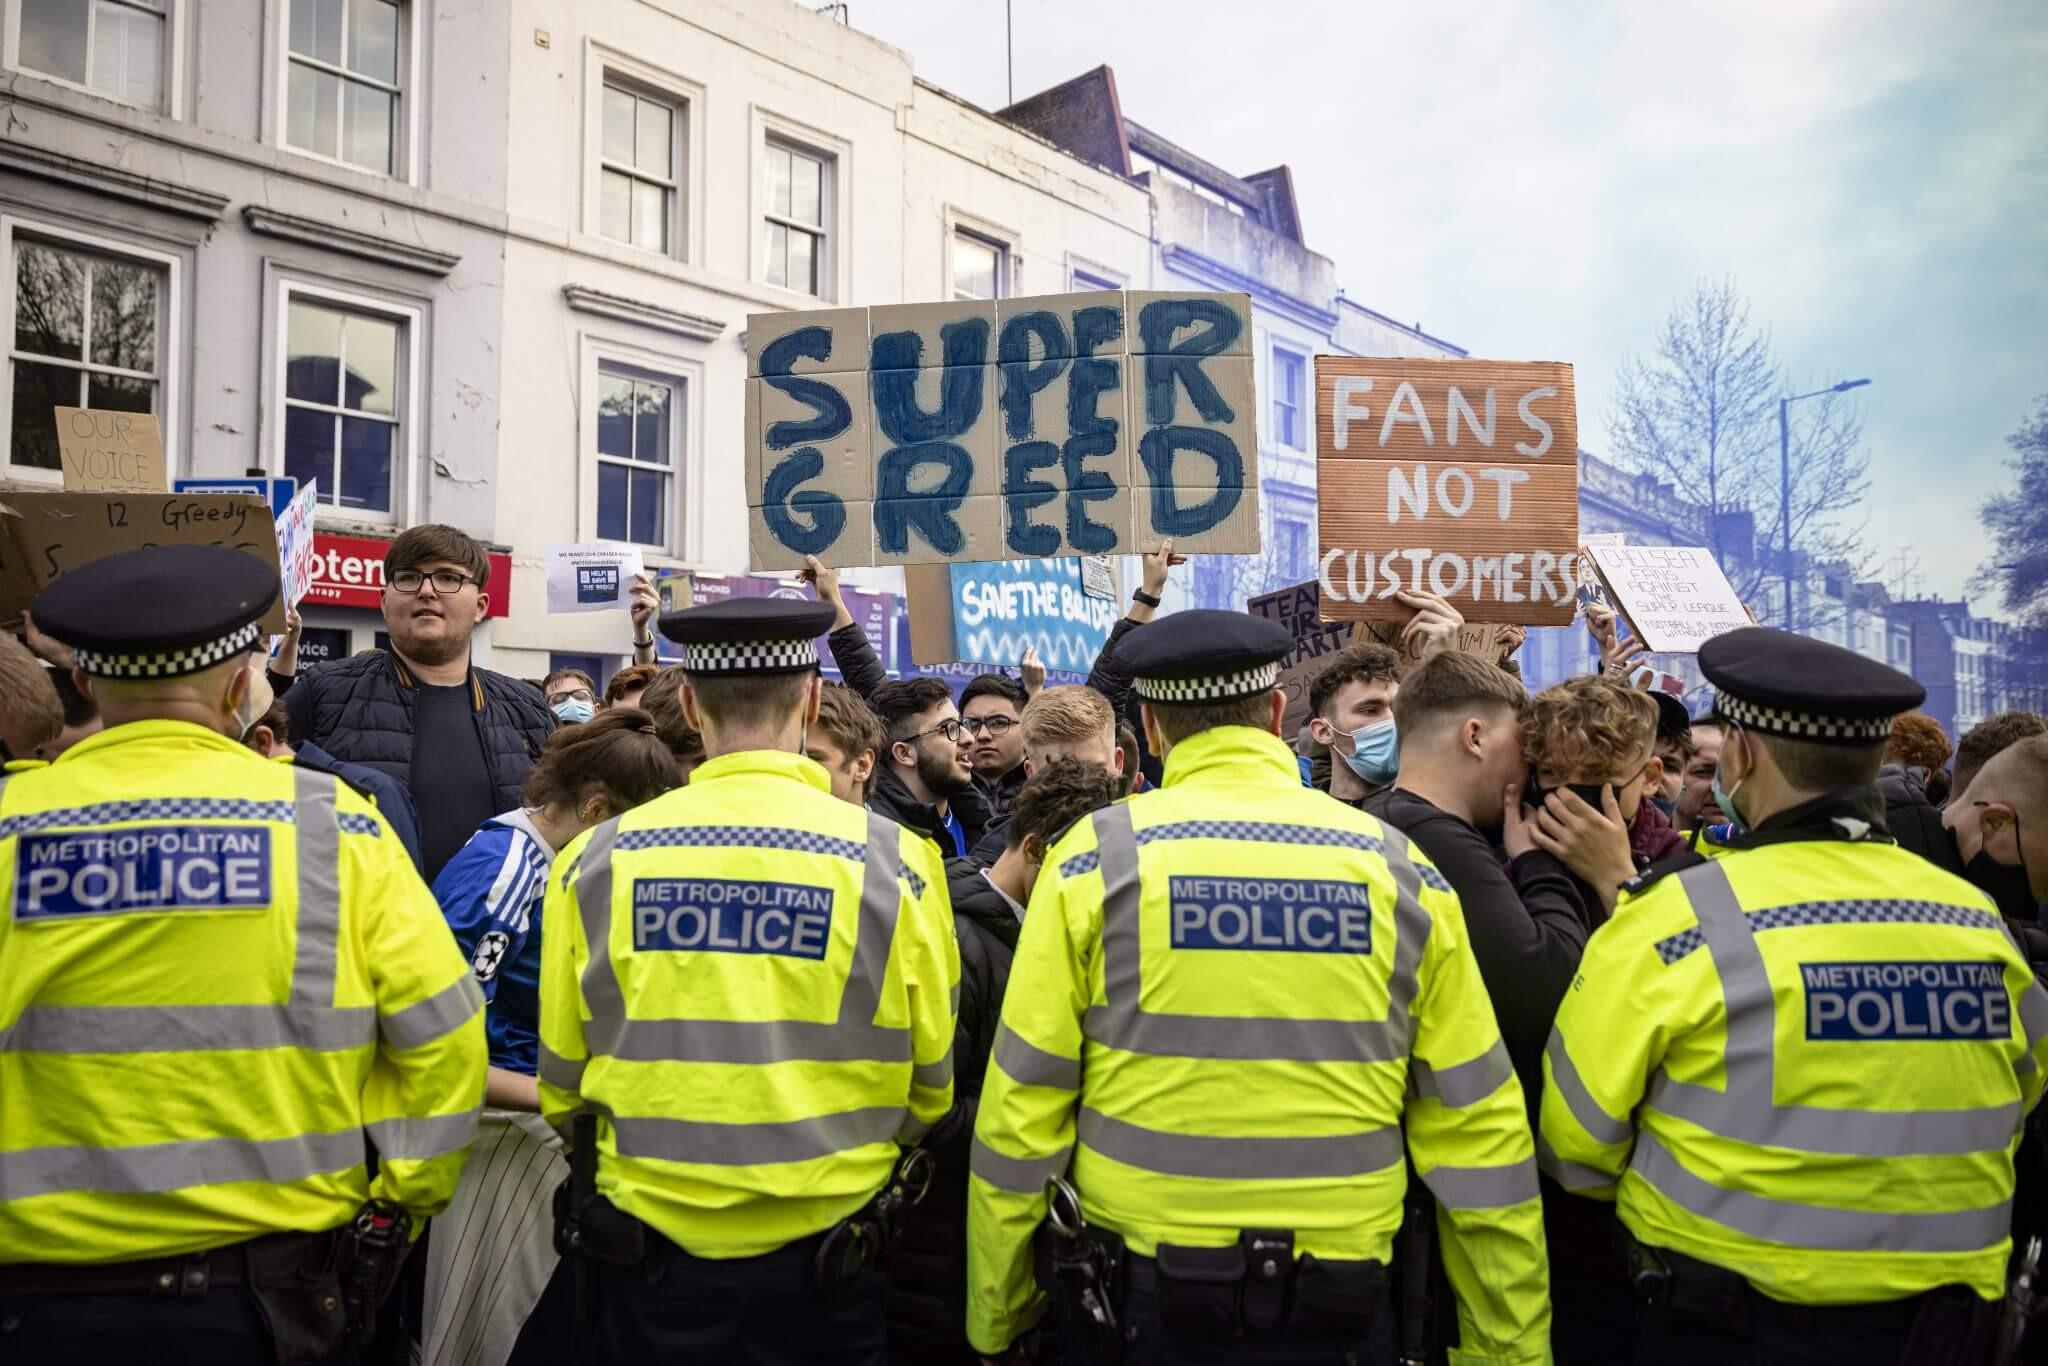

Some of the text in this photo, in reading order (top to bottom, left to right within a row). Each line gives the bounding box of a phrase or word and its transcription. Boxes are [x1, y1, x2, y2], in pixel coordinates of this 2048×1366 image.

[759, 299, 1243, 449] SUPER
[71, 412, 132, 445] OUR
[1333, 376, 1558, 458] FANS
[65, 447, 149, 483] VOICE
[762, 424, 1245, 557] GREED
[1387, 464, 1531, 524] NOT
[106, 500, 249, 536] 12 Greedy
[1318, 548, 1579, 608] CUSTOMERS
[1600, 549, 1700, 569] CHELSEA
[30, 833, 261, 864] METROPOLITAN
[27, 858, 261, 912] POLICE
[635, 883, 831, 911] METROPOLITAN
[1172, 880, 1367, 905] METROPOLITAN
[635, 906, 827, 955] POLICE
[1173, 903, 1369, 948] POLICE
[1805, 965, 2003, 988] METROPOLITAN
[1810, 991, 2007, 1035] POLICE
